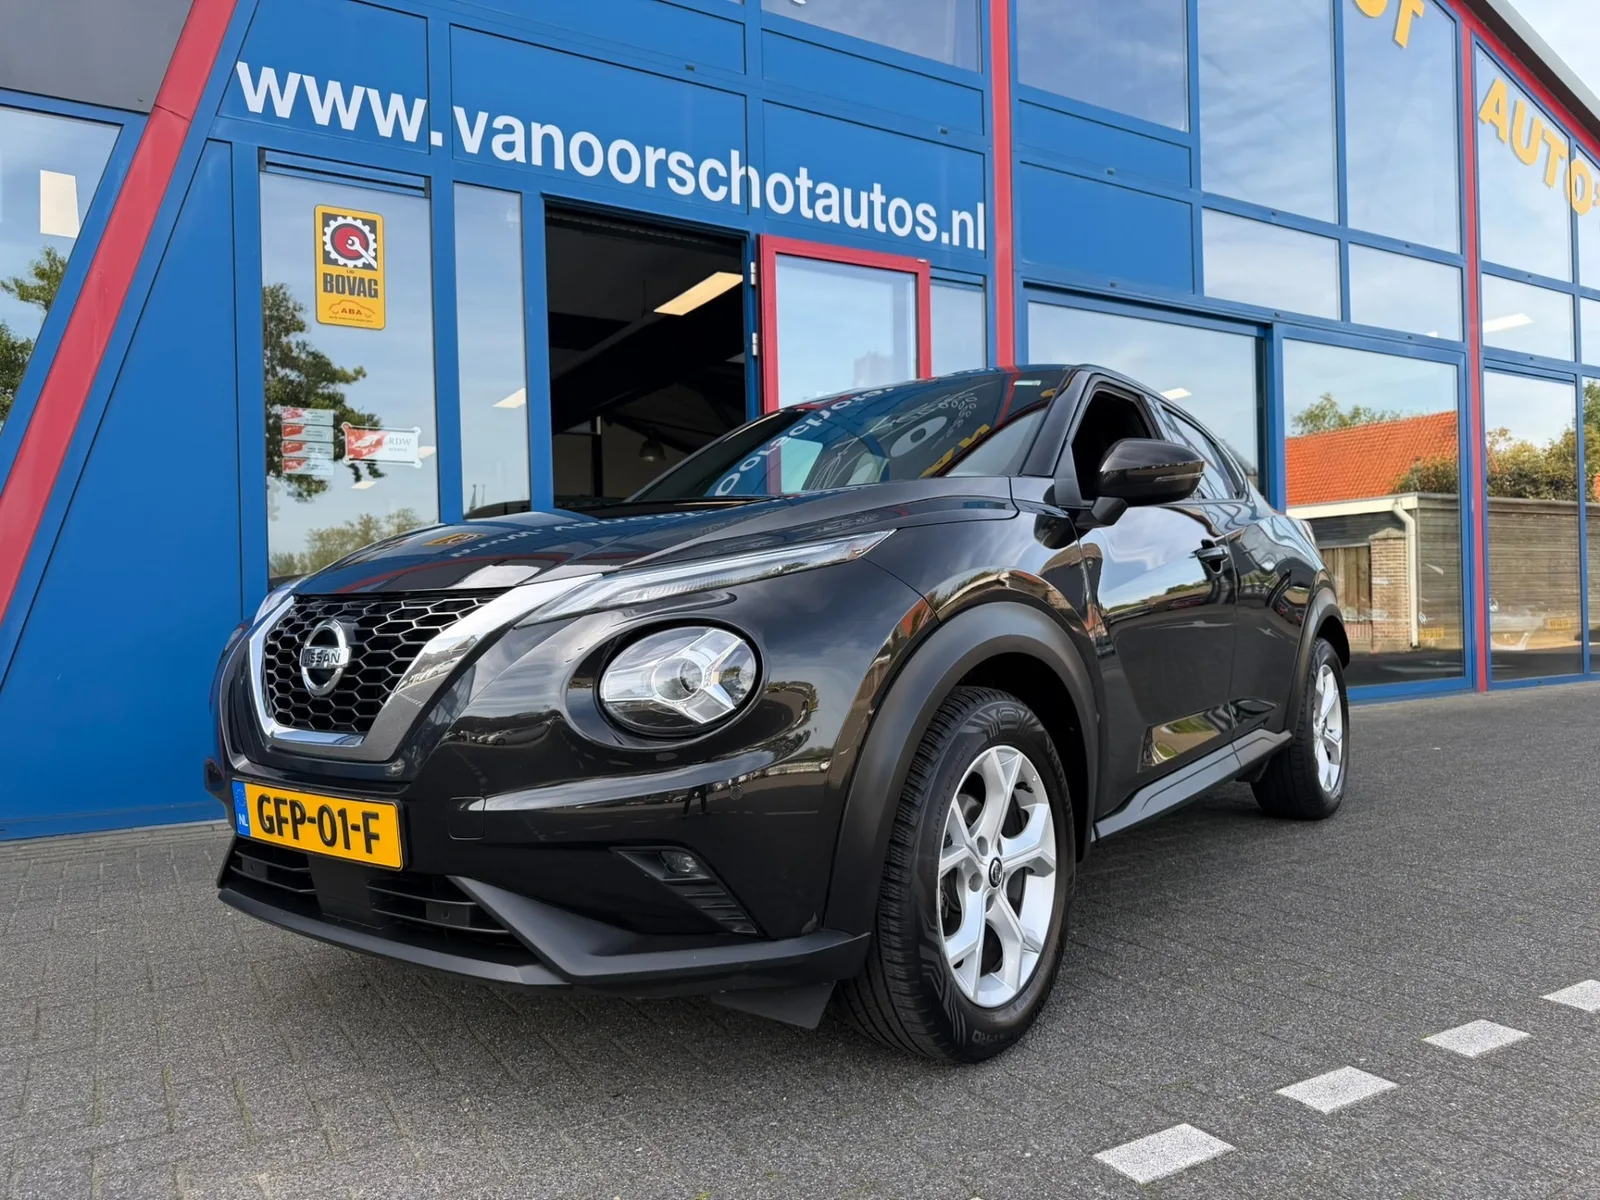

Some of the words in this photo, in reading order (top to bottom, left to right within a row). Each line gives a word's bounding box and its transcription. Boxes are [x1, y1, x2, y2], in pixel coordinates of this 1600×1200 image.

[236, 61, 984, 250] www.vanoorschotautos.nl
[1478, 76, 1600, 216] AUTO
[322, 272, 379, 299] BOVAG
[341, 307, 363, 316] ABA
[389, 436, 412, 446] RDW
[302, 650, 341, 664] NISSAN
[238, 813, 249, 827] NL
[257, 793, 380, 855] GFP-01-F
